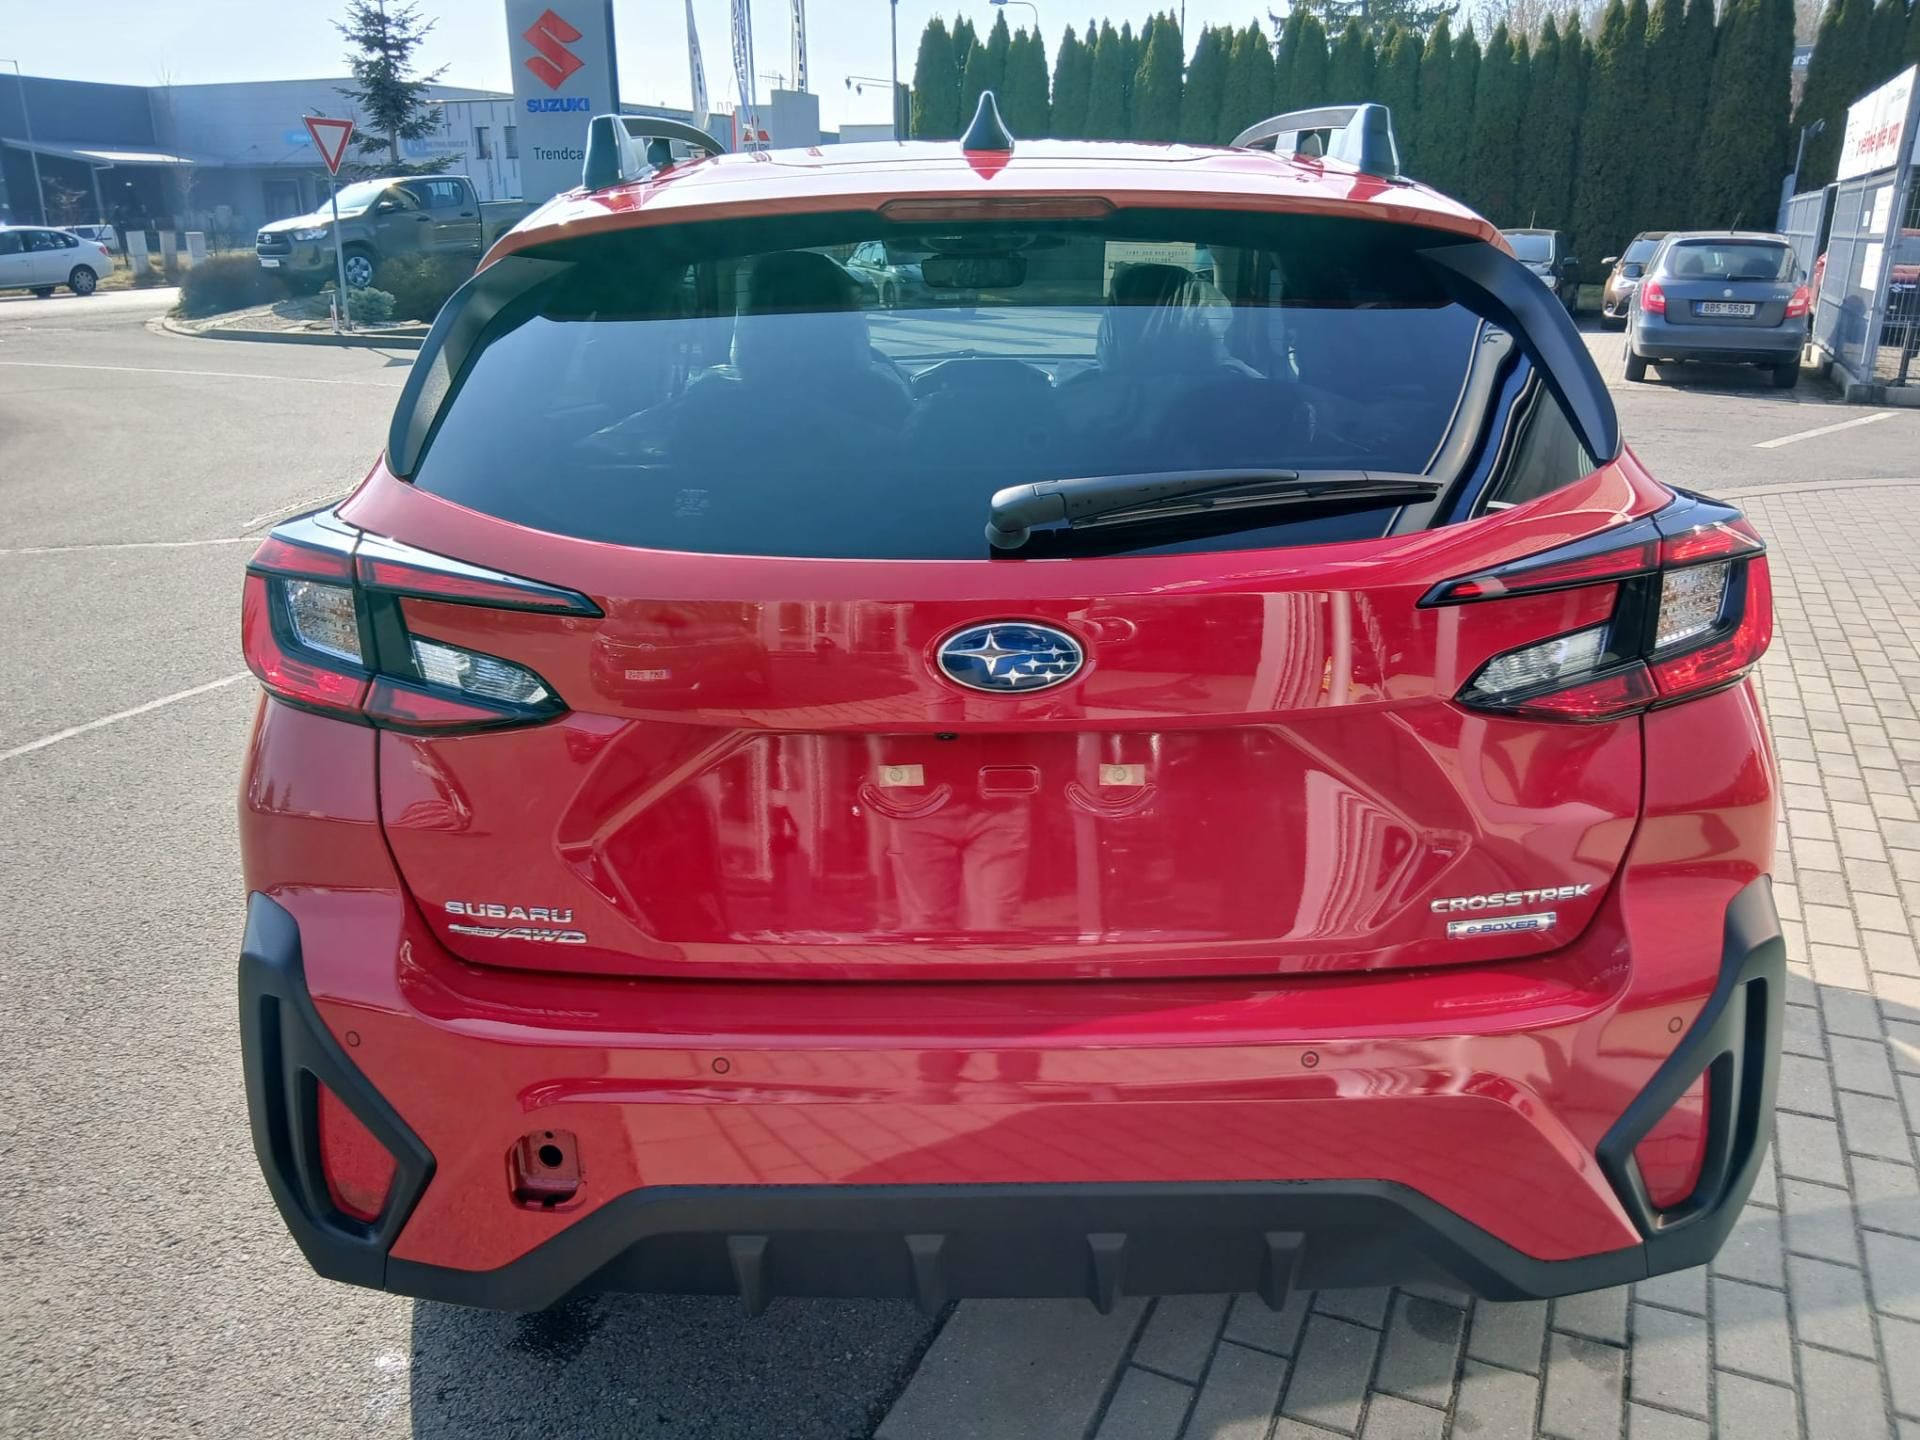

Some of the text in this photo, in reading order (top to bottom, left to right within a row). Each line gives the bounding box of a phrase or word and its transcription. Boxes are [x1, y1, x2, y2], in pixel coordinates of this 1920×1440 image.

[527, 97, 590, 112] SUZUKI
[533, 147, 585, 160] Trendca
[1430, 884, 1592, 913] CROSSTREK
[445, 901, 573, 923] SUBARU
[1466, 919, 1539, 934] e-BOXER
[501, 928, 587, 944] AWD
